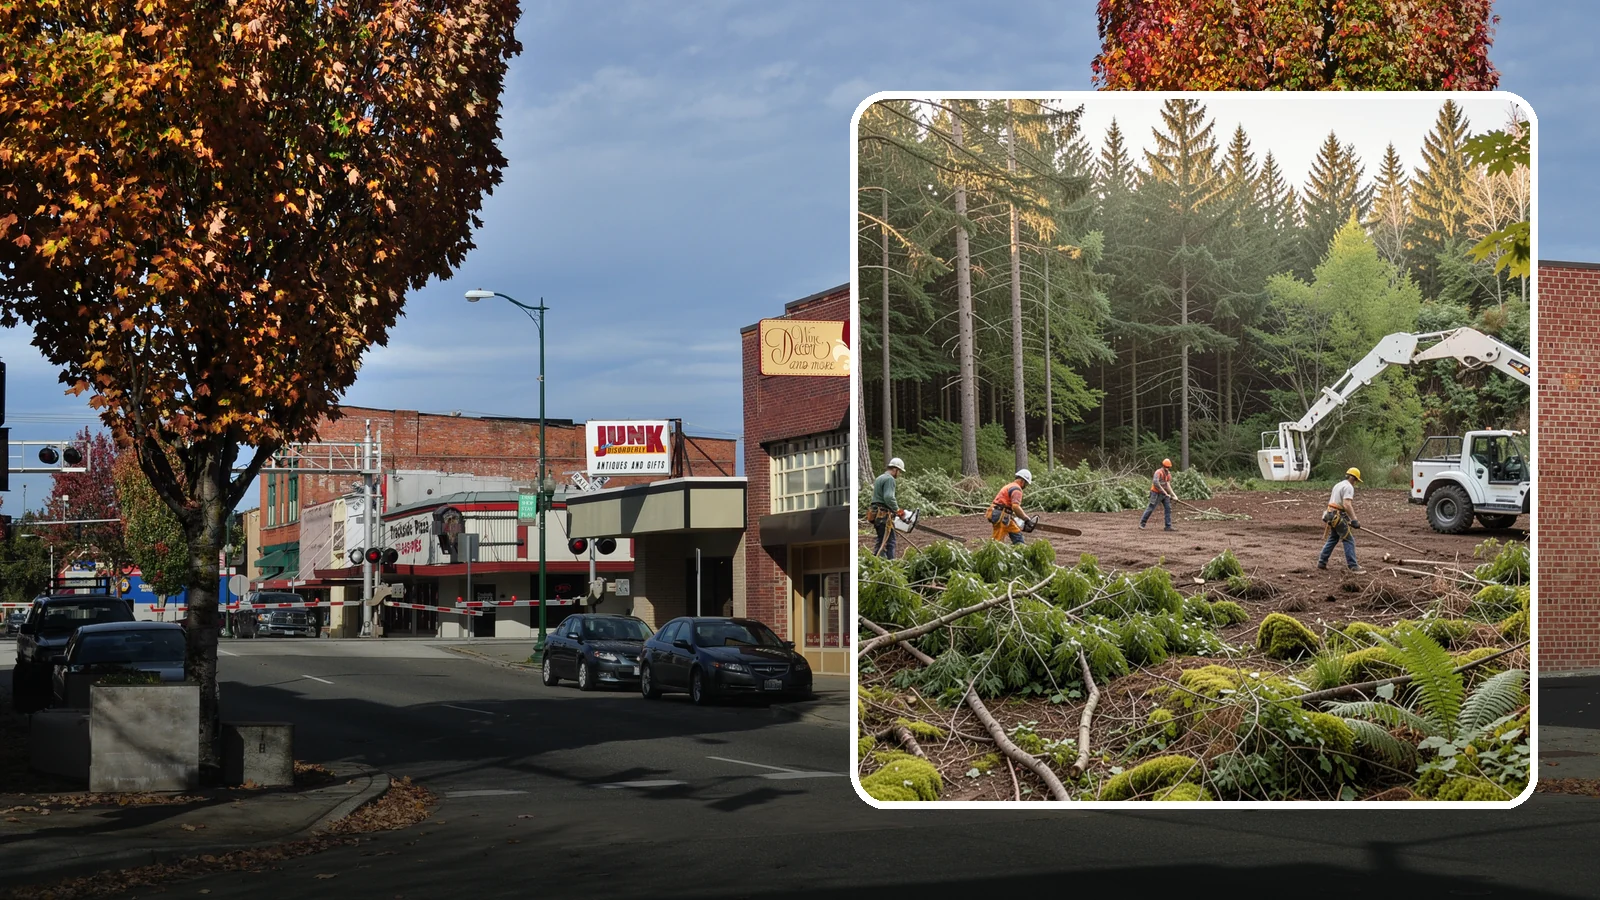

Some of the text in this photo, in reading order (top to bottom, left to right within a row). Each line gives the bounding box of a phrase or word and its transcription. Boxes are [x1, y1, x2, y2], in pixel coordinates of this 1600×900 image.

[595, 425, 665, 457] JUNK
[607, 446, 645, 454] DISORDERLY
[597, 460, 665, 470] ANTIQUES AND GIFTS
[414, 520, 429, 534] Pizza
